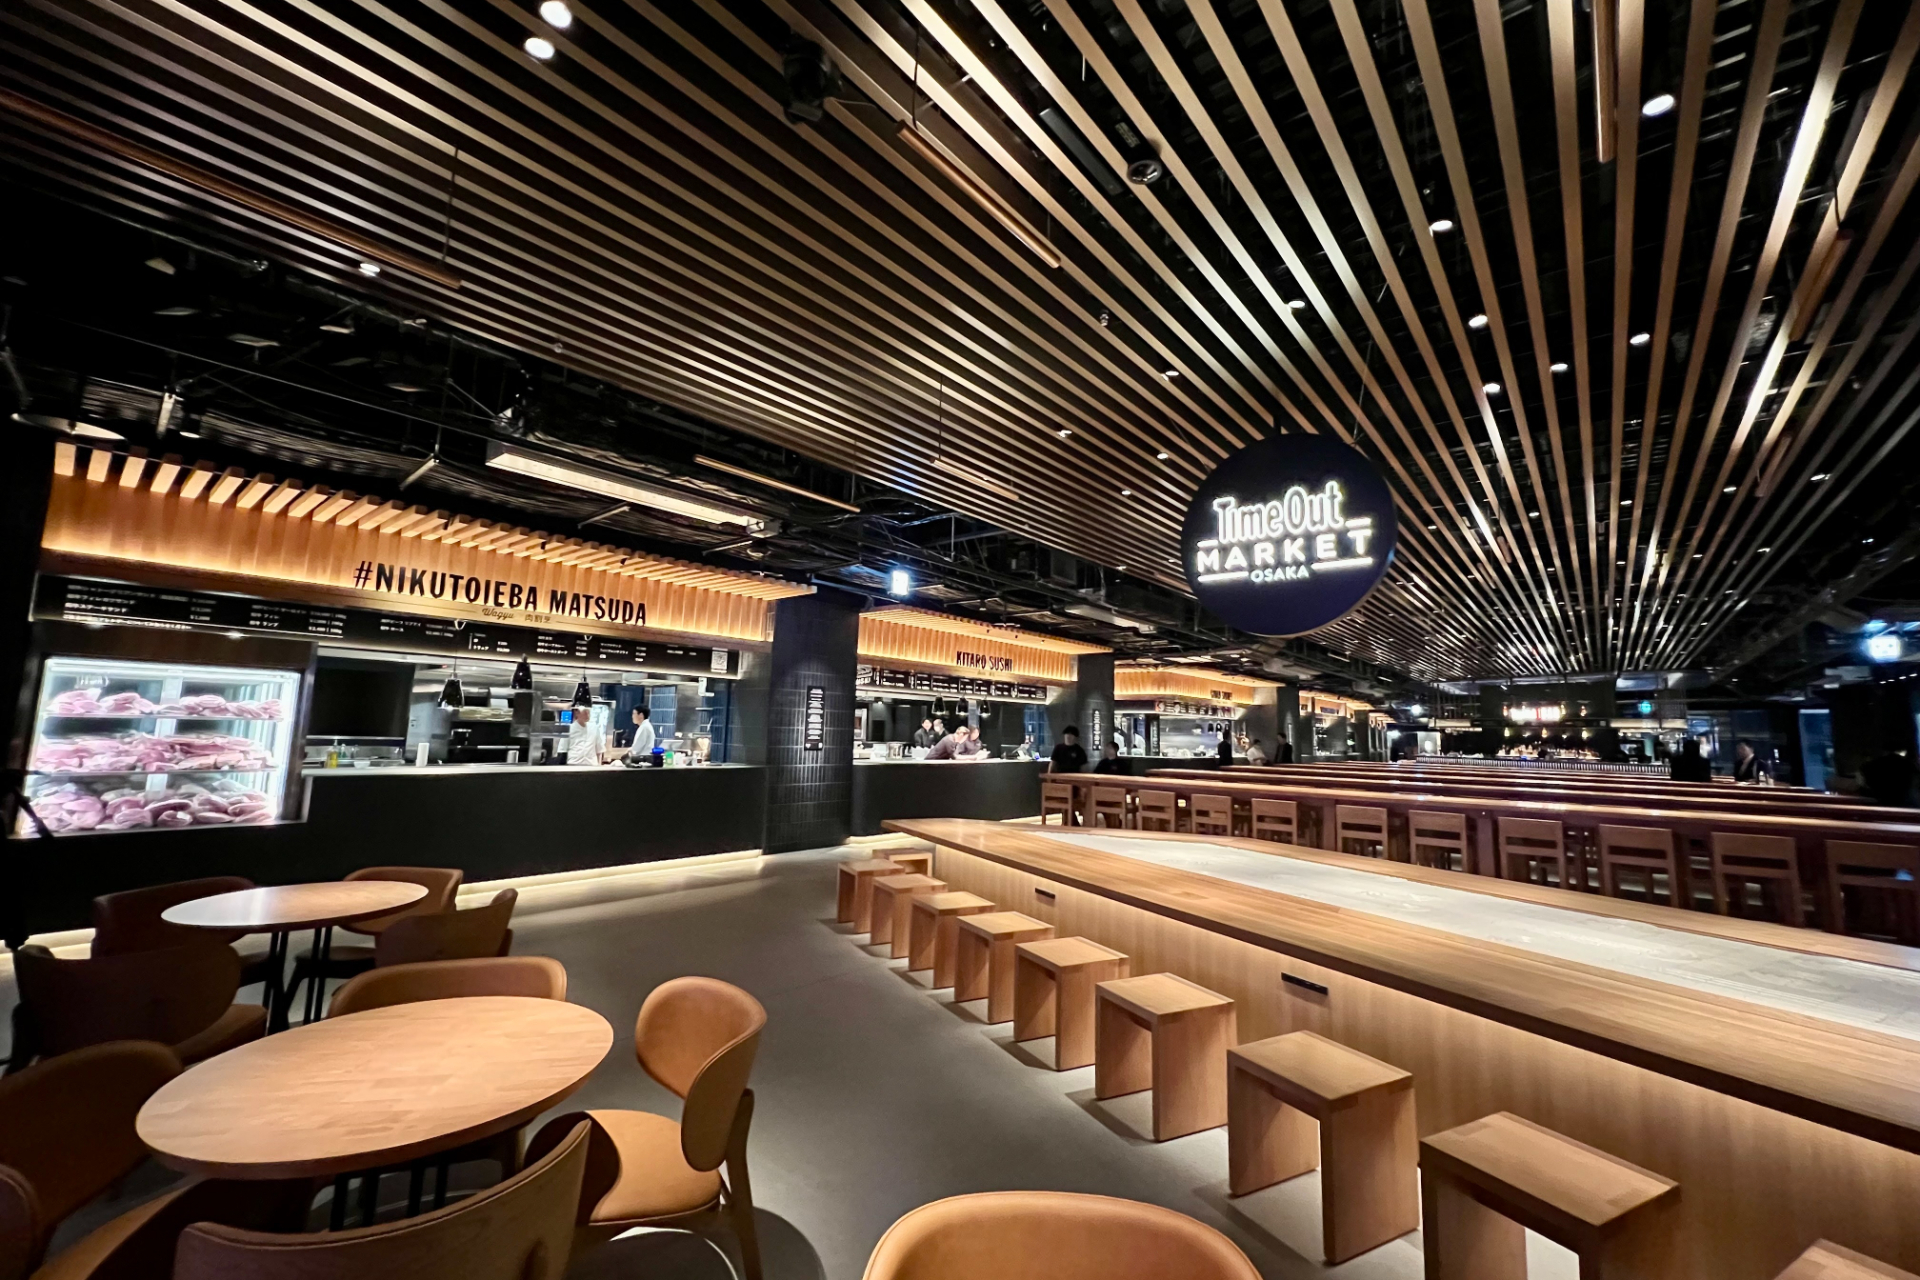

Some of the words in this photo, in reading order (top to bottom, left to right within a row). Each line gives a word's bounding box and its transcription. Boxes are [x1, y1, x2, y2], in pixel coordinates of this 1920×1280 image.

[1197, 528, 1373, 572] MARKET
[1250, 565, 1309, 583] OSAKA
[353, 560, 538, 611] #NIKUTOIEBA
[550, 590, 646, 626] MATSUDA
[482, 608, 514, 620] Wagyu
[956, 650, 986, 669] KITARO
[989, 655, 1013, 672] SUSHI
